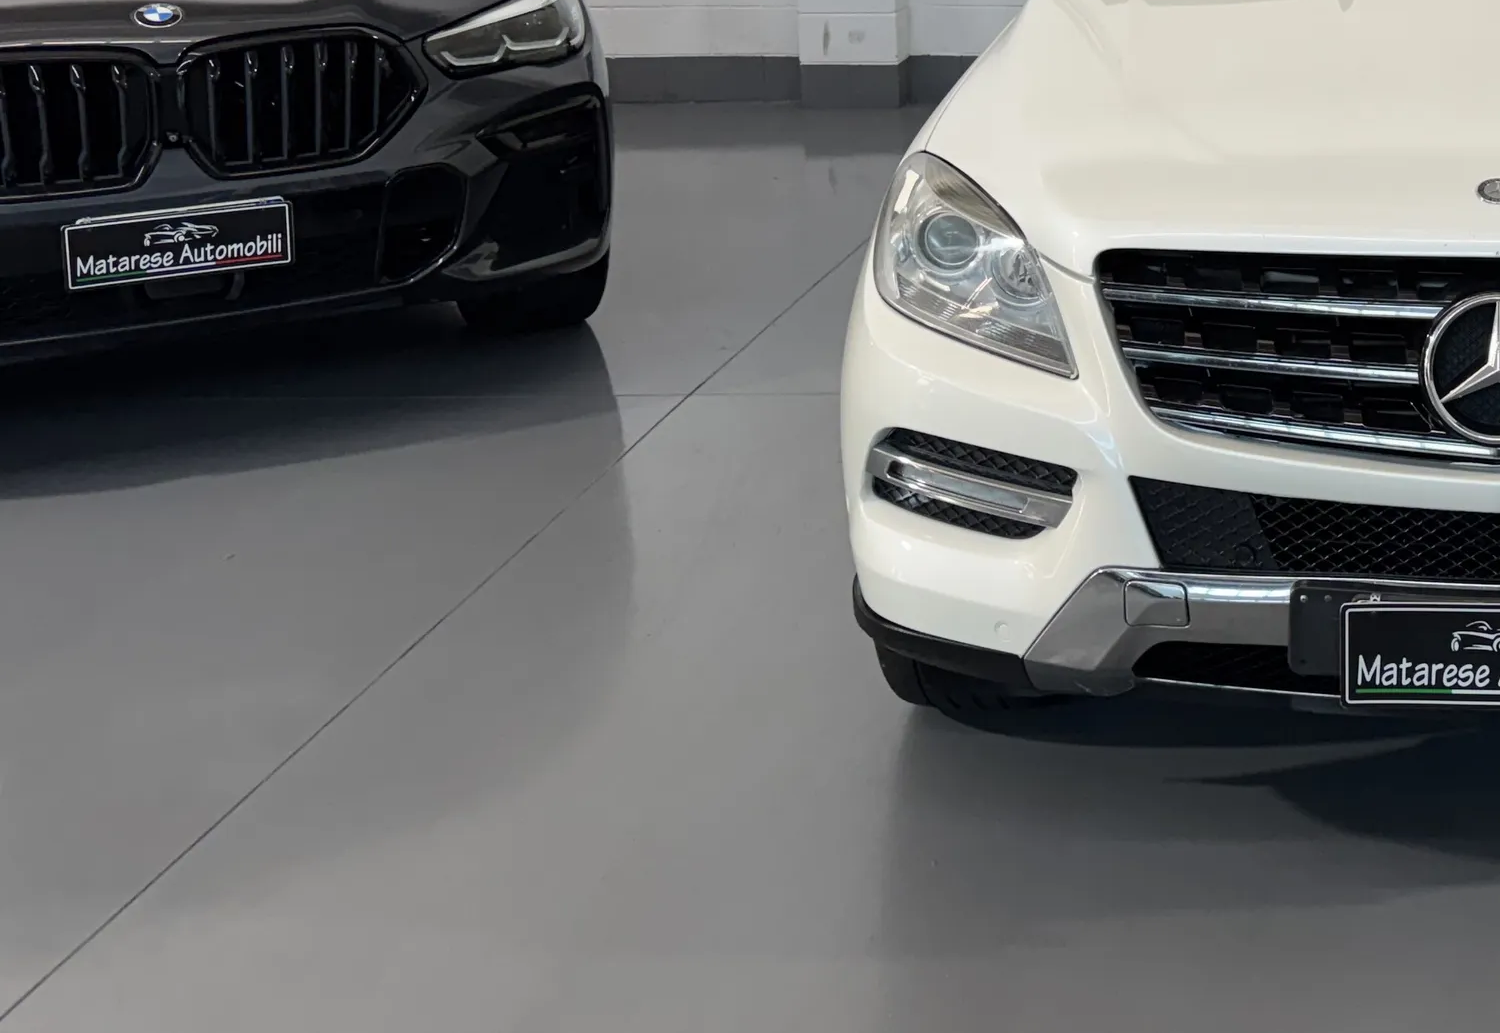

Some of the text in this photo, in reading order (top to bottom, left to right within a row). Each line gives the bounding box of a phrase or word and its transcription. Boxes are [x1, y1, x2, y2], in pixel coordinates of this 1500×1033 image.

[77, 233, 282, 277] Matarese Automobili
[1357, 654, 1490, 688] Matarese
